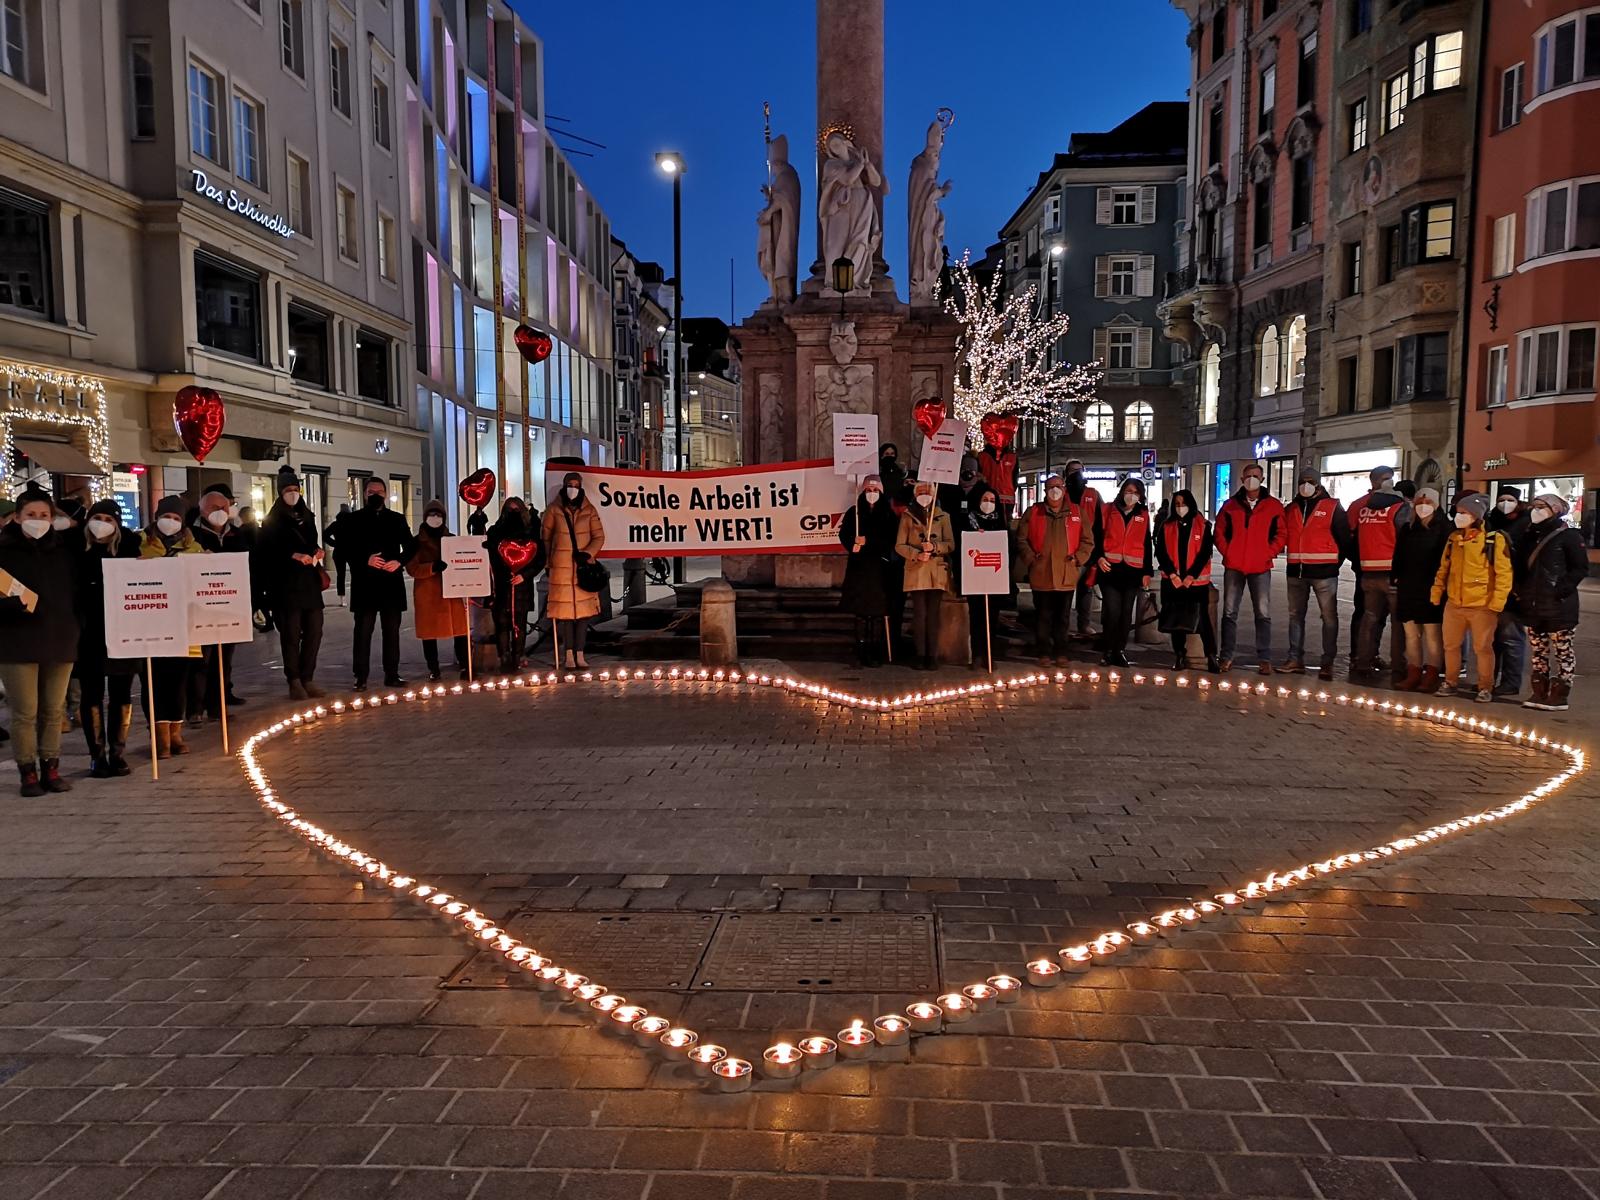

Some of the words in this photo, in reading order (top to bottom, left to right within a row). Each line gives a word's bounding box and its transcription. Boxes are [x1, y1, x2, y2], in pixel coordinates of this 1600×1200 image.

[192, 169, 224, 204] Das
[227, 189, 295, 238] Schindler
[598, 482, 680, 510] Soziale
[689, 485, 761, 511] Arbeit
[769, 482, 799, 508] ist
[629, 517, 687, 543] mehr
[695, 517, 773, 543] WERT!
[124, 593, 168, 601] KLEINERE
[196, 589, 238, 597] STRATEGIEN
[123, 602, 169, 611] GRUPPEN
